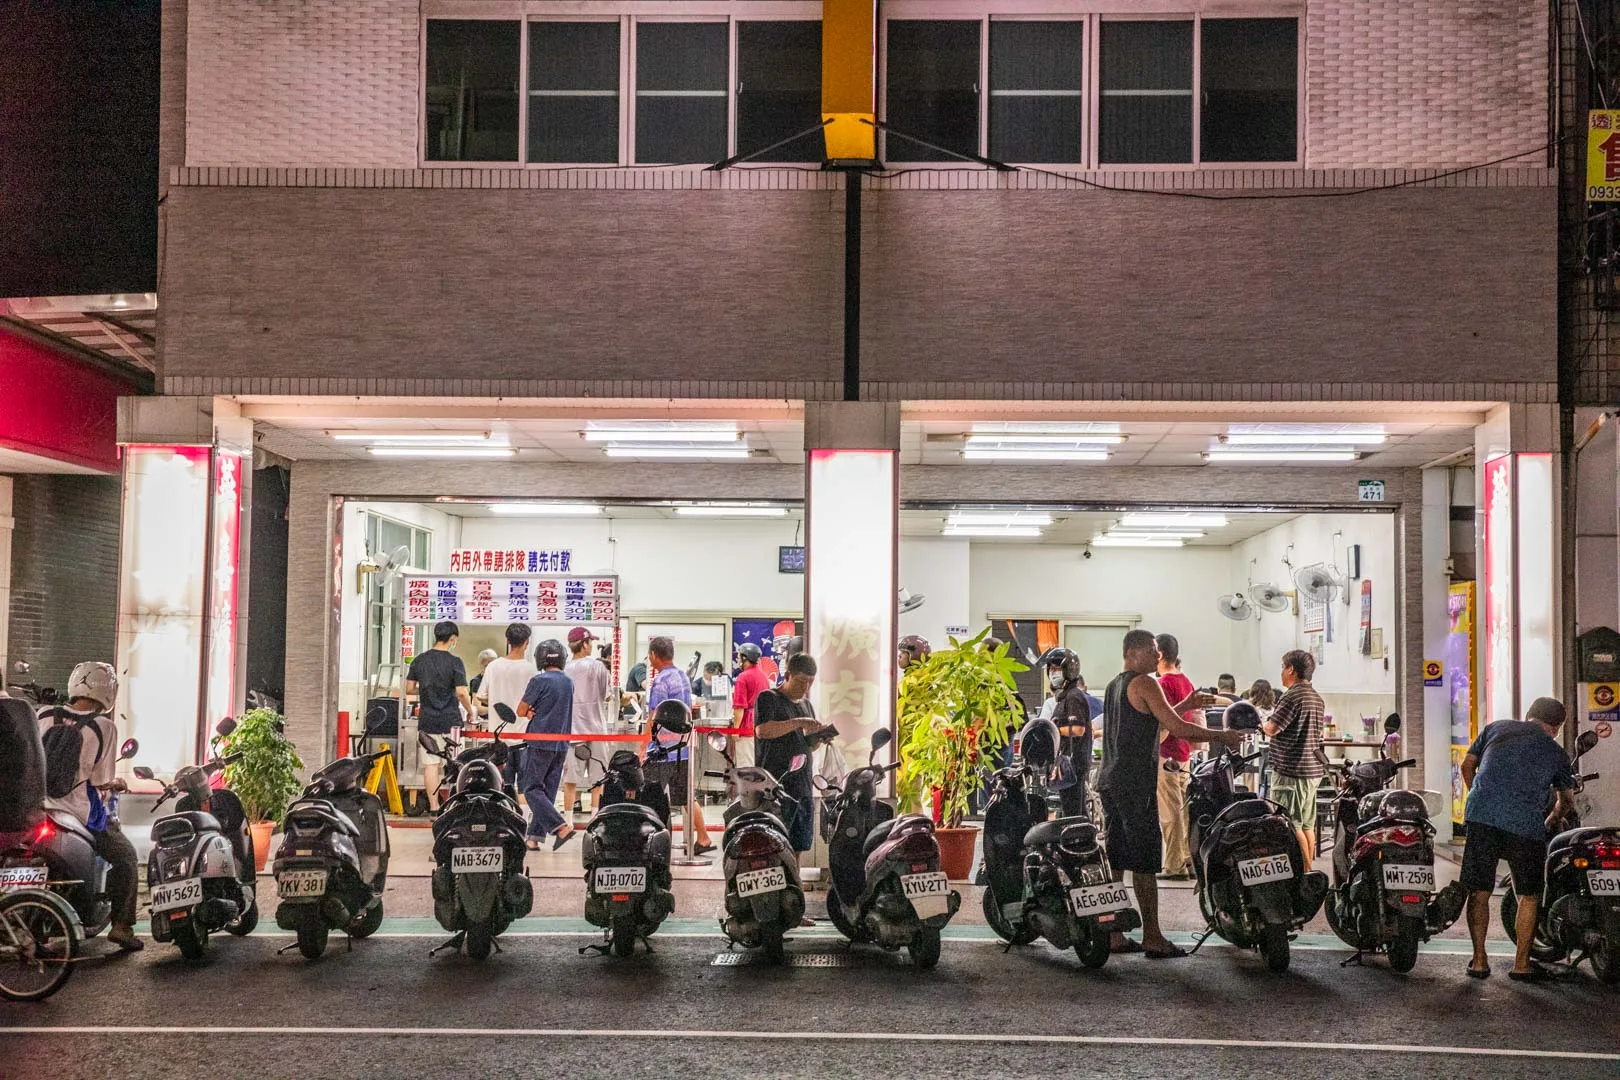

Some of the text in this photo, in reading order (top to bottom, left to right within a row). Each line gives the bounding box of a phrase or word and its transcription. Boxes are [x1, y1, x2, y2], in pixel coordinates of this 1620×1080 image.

[1363, 491, 1381, 500] 471
[528, 550, 571, 572] 請先付款
